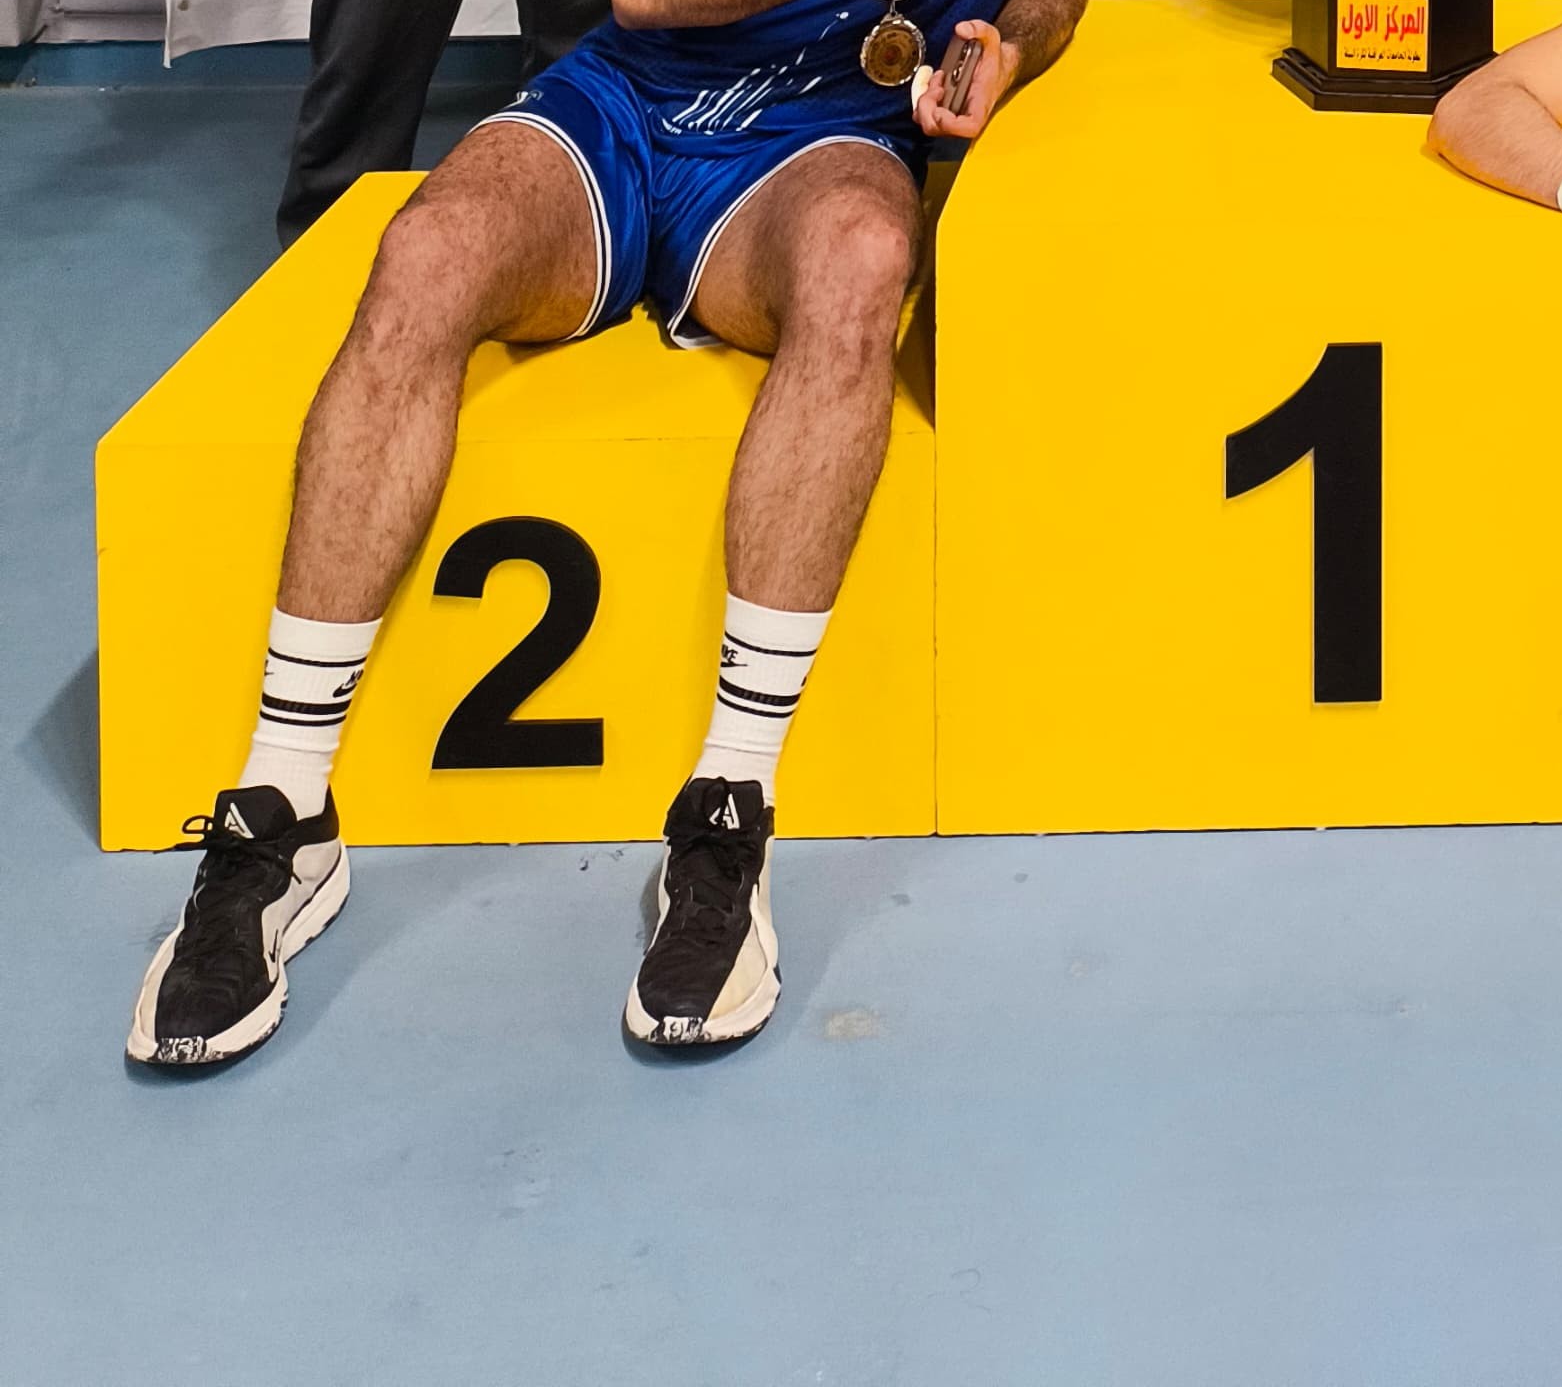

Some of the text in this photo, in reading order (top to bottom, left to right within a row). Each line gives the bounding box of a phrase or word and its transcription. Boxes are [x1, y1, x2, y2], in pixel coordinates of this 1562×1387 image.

[1341, 3, 1425, 42] المركز الاول
[431, 514, 605, 772] 2
[1223, 340, 1384, 706] 1
